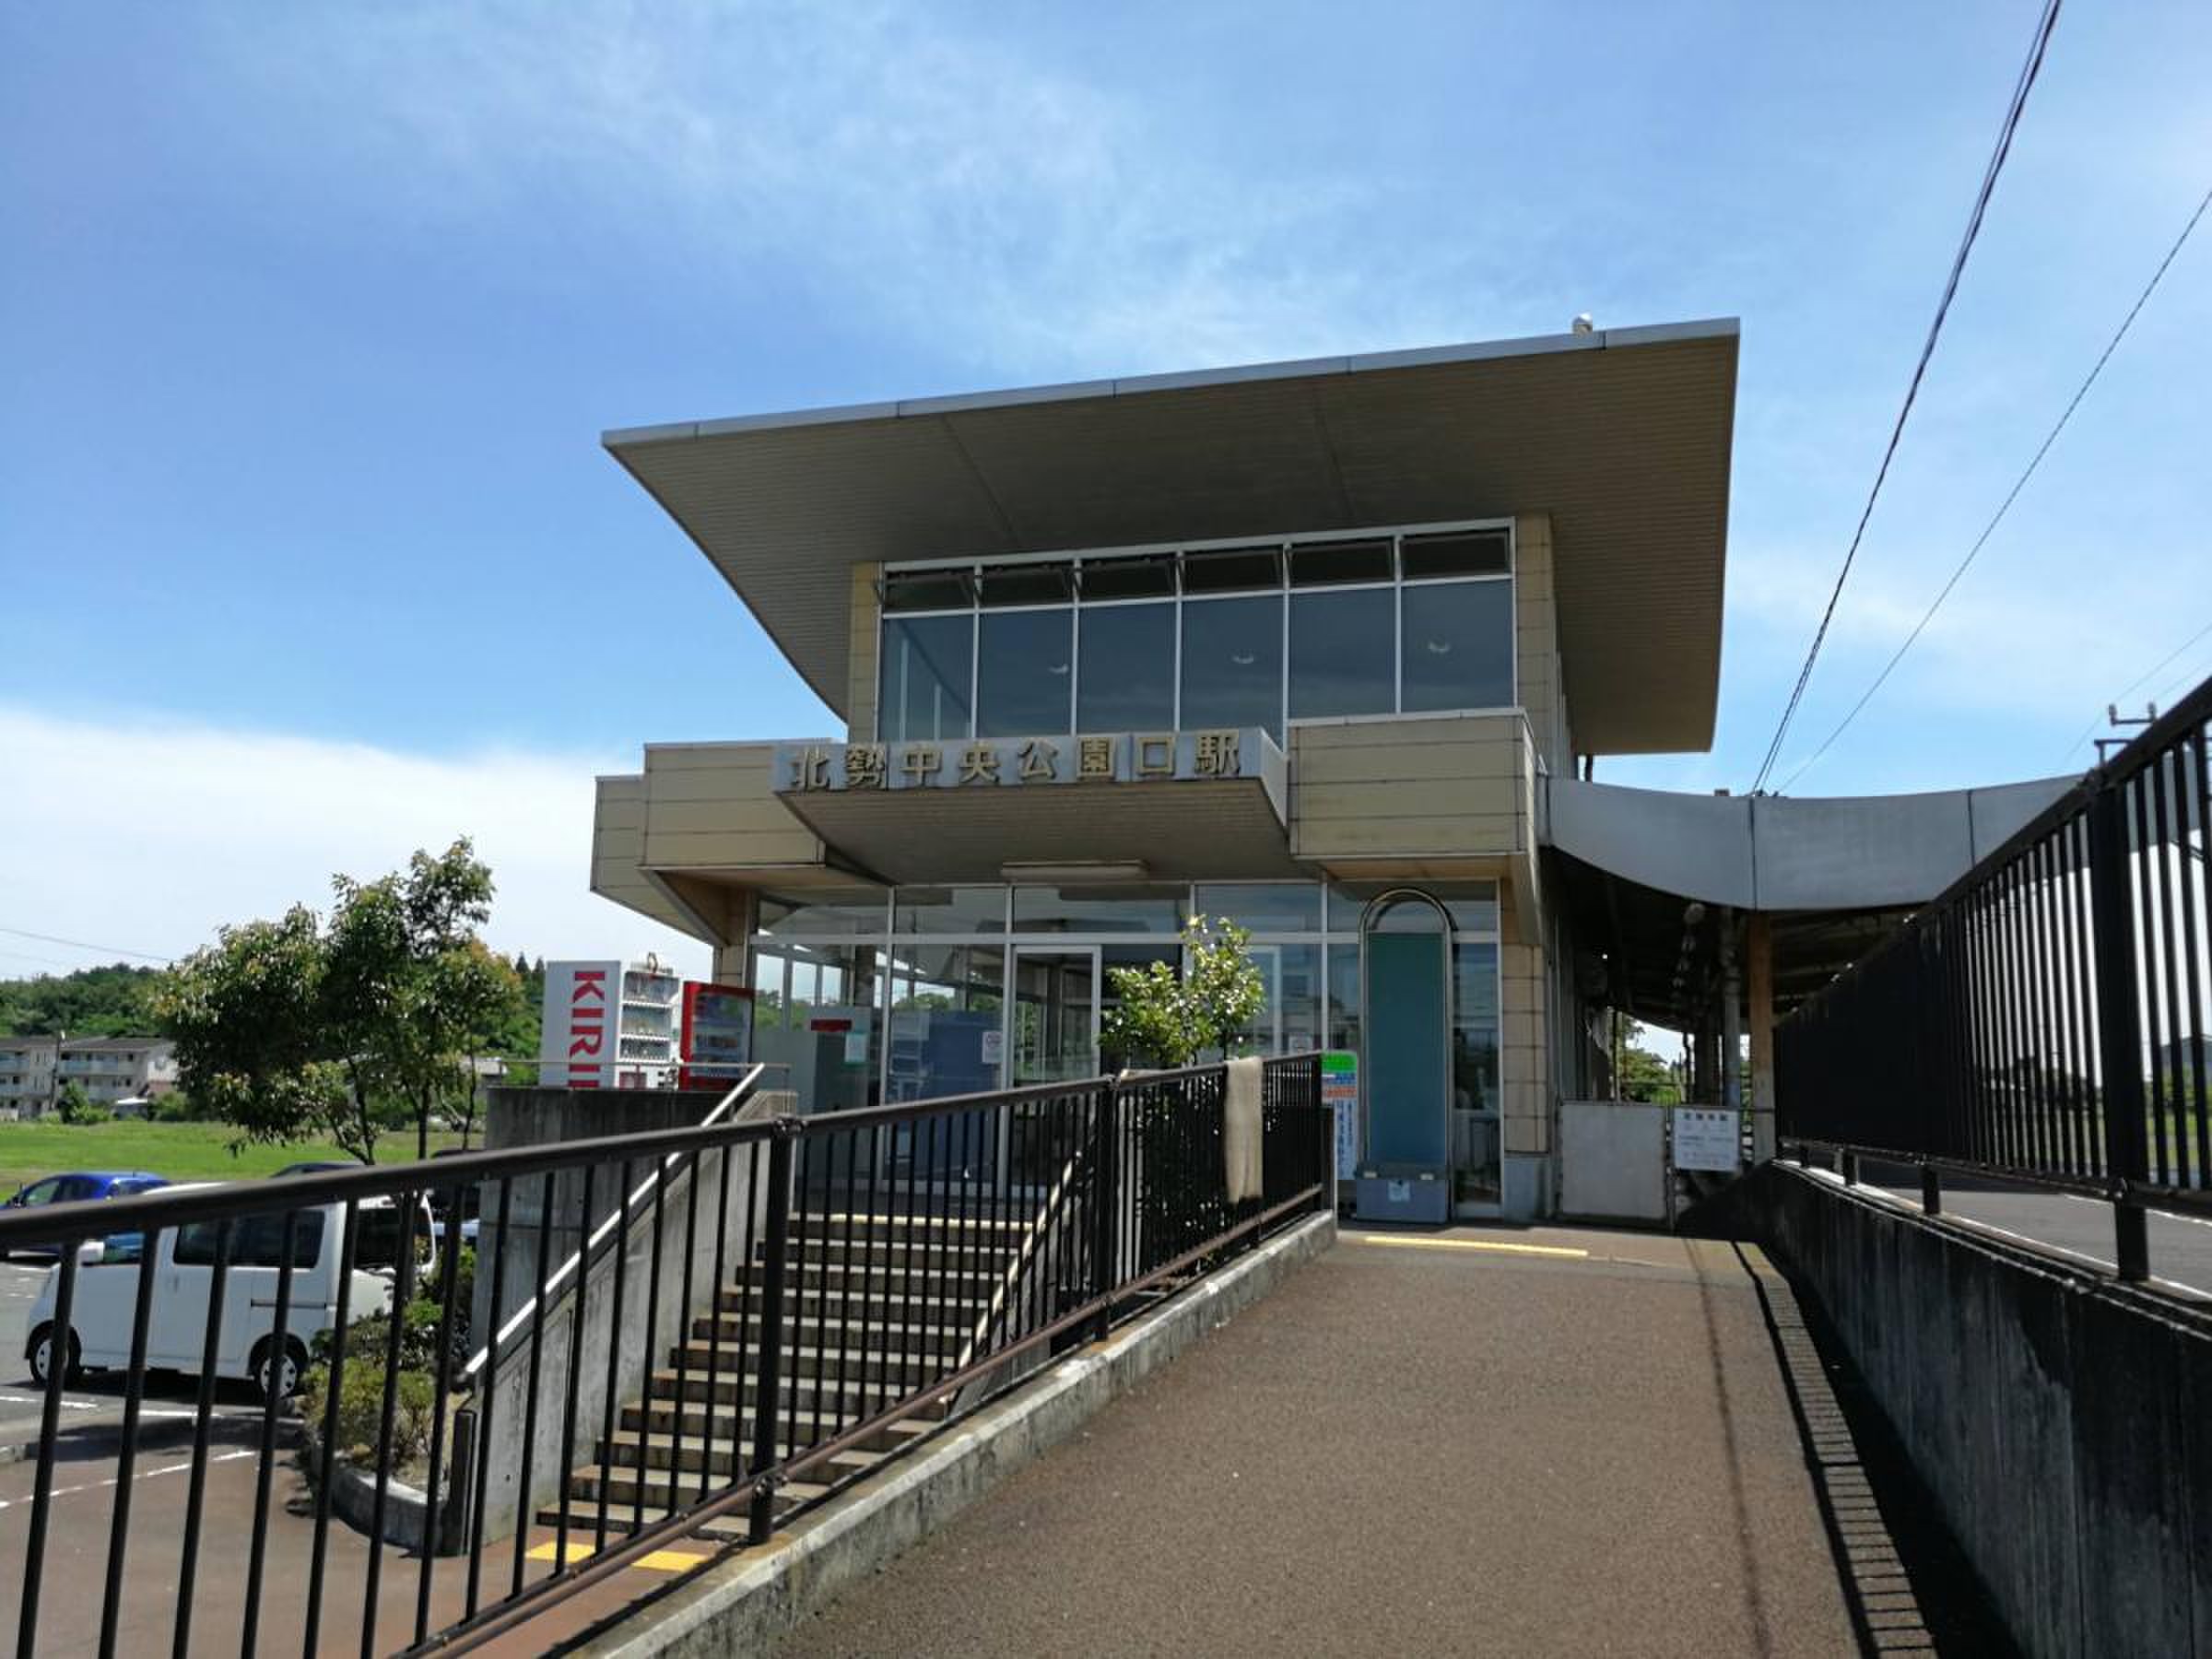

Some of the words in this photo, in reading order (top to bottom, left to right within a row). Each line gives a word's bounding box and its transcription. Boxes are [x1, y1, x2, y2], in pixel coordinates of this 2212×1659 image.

[792, 735, 1240, 789] 北勢中央公園口駅
[568, 971, 606, 1088] KIRI
